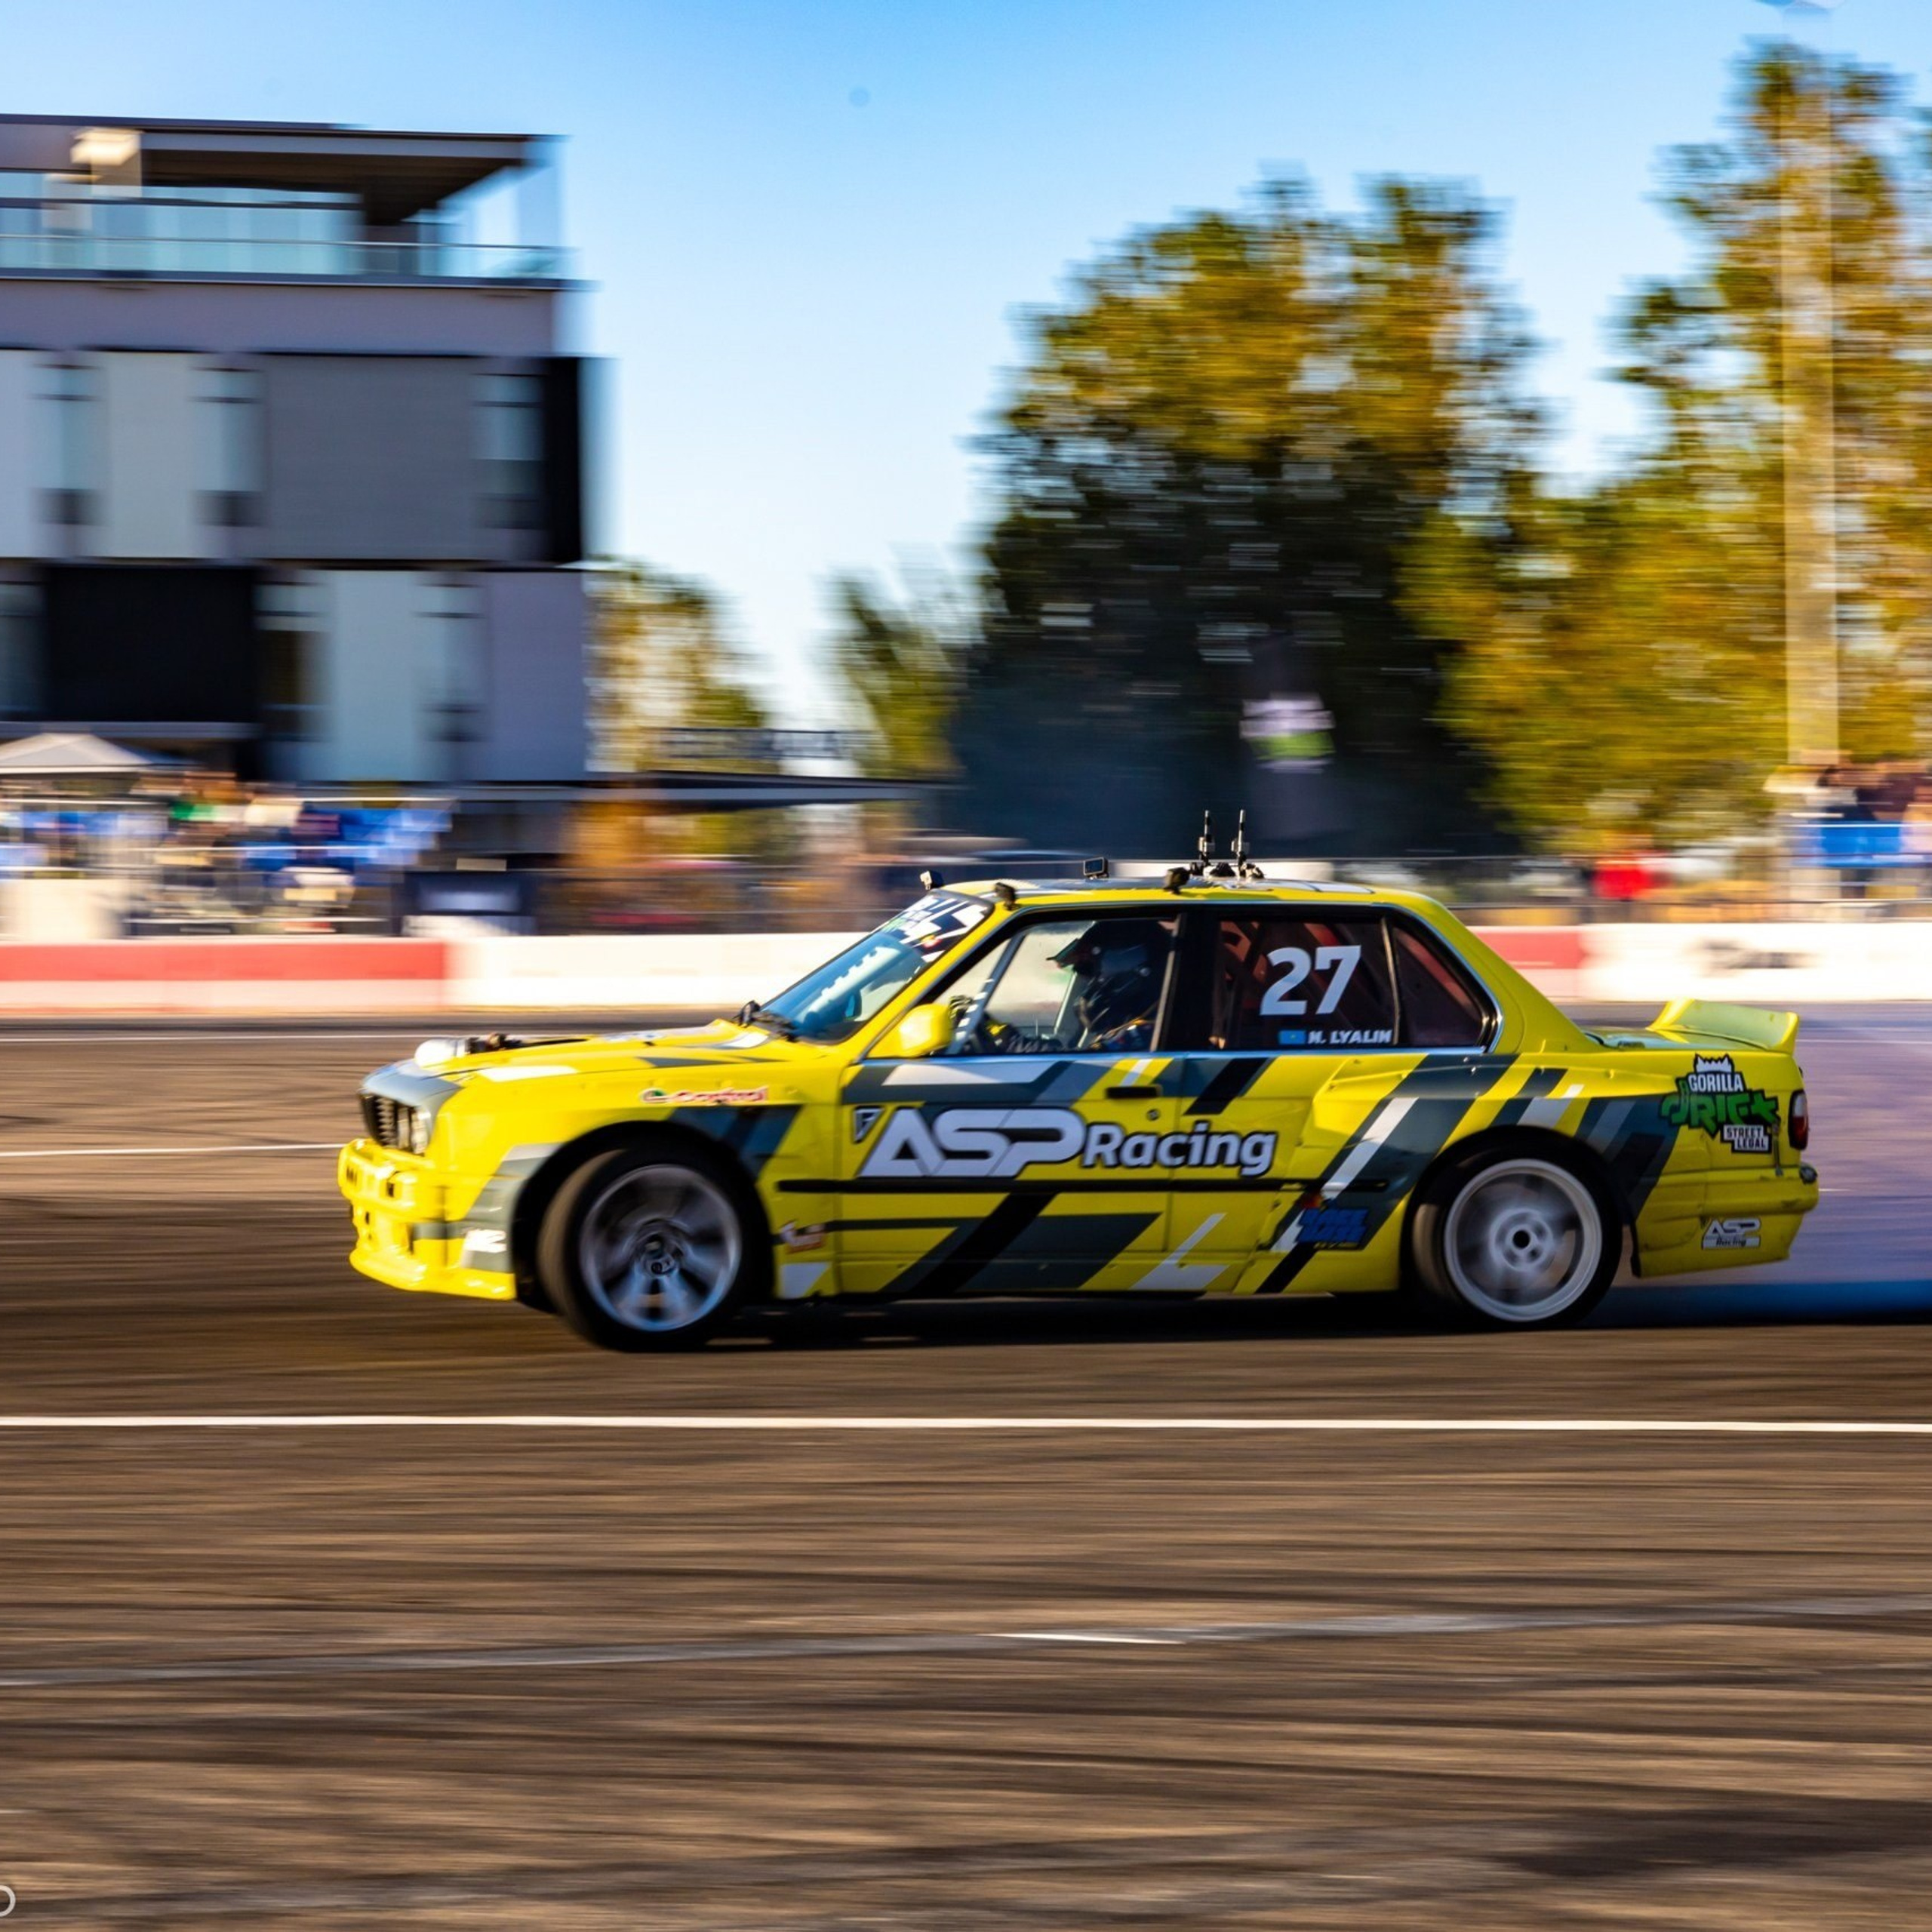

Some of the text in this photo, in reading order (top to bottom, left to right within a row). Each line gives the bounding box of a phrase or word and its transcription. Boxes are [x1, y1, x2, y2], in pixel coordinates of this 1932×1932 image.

[1259, 945, 1361, 1016] 27
[1329, 1029, 1392, 1044] LYALIN
[1687, 1074, 1744, 1093] GORILLA
[1725, 1126, 1762, 1138] STREET
[859, 1108, 1277, 1177] ASP Racing
[1737, 1138, 1767, 1149] LEGAL
[1706, 1218, 1761, 1235] ASP
